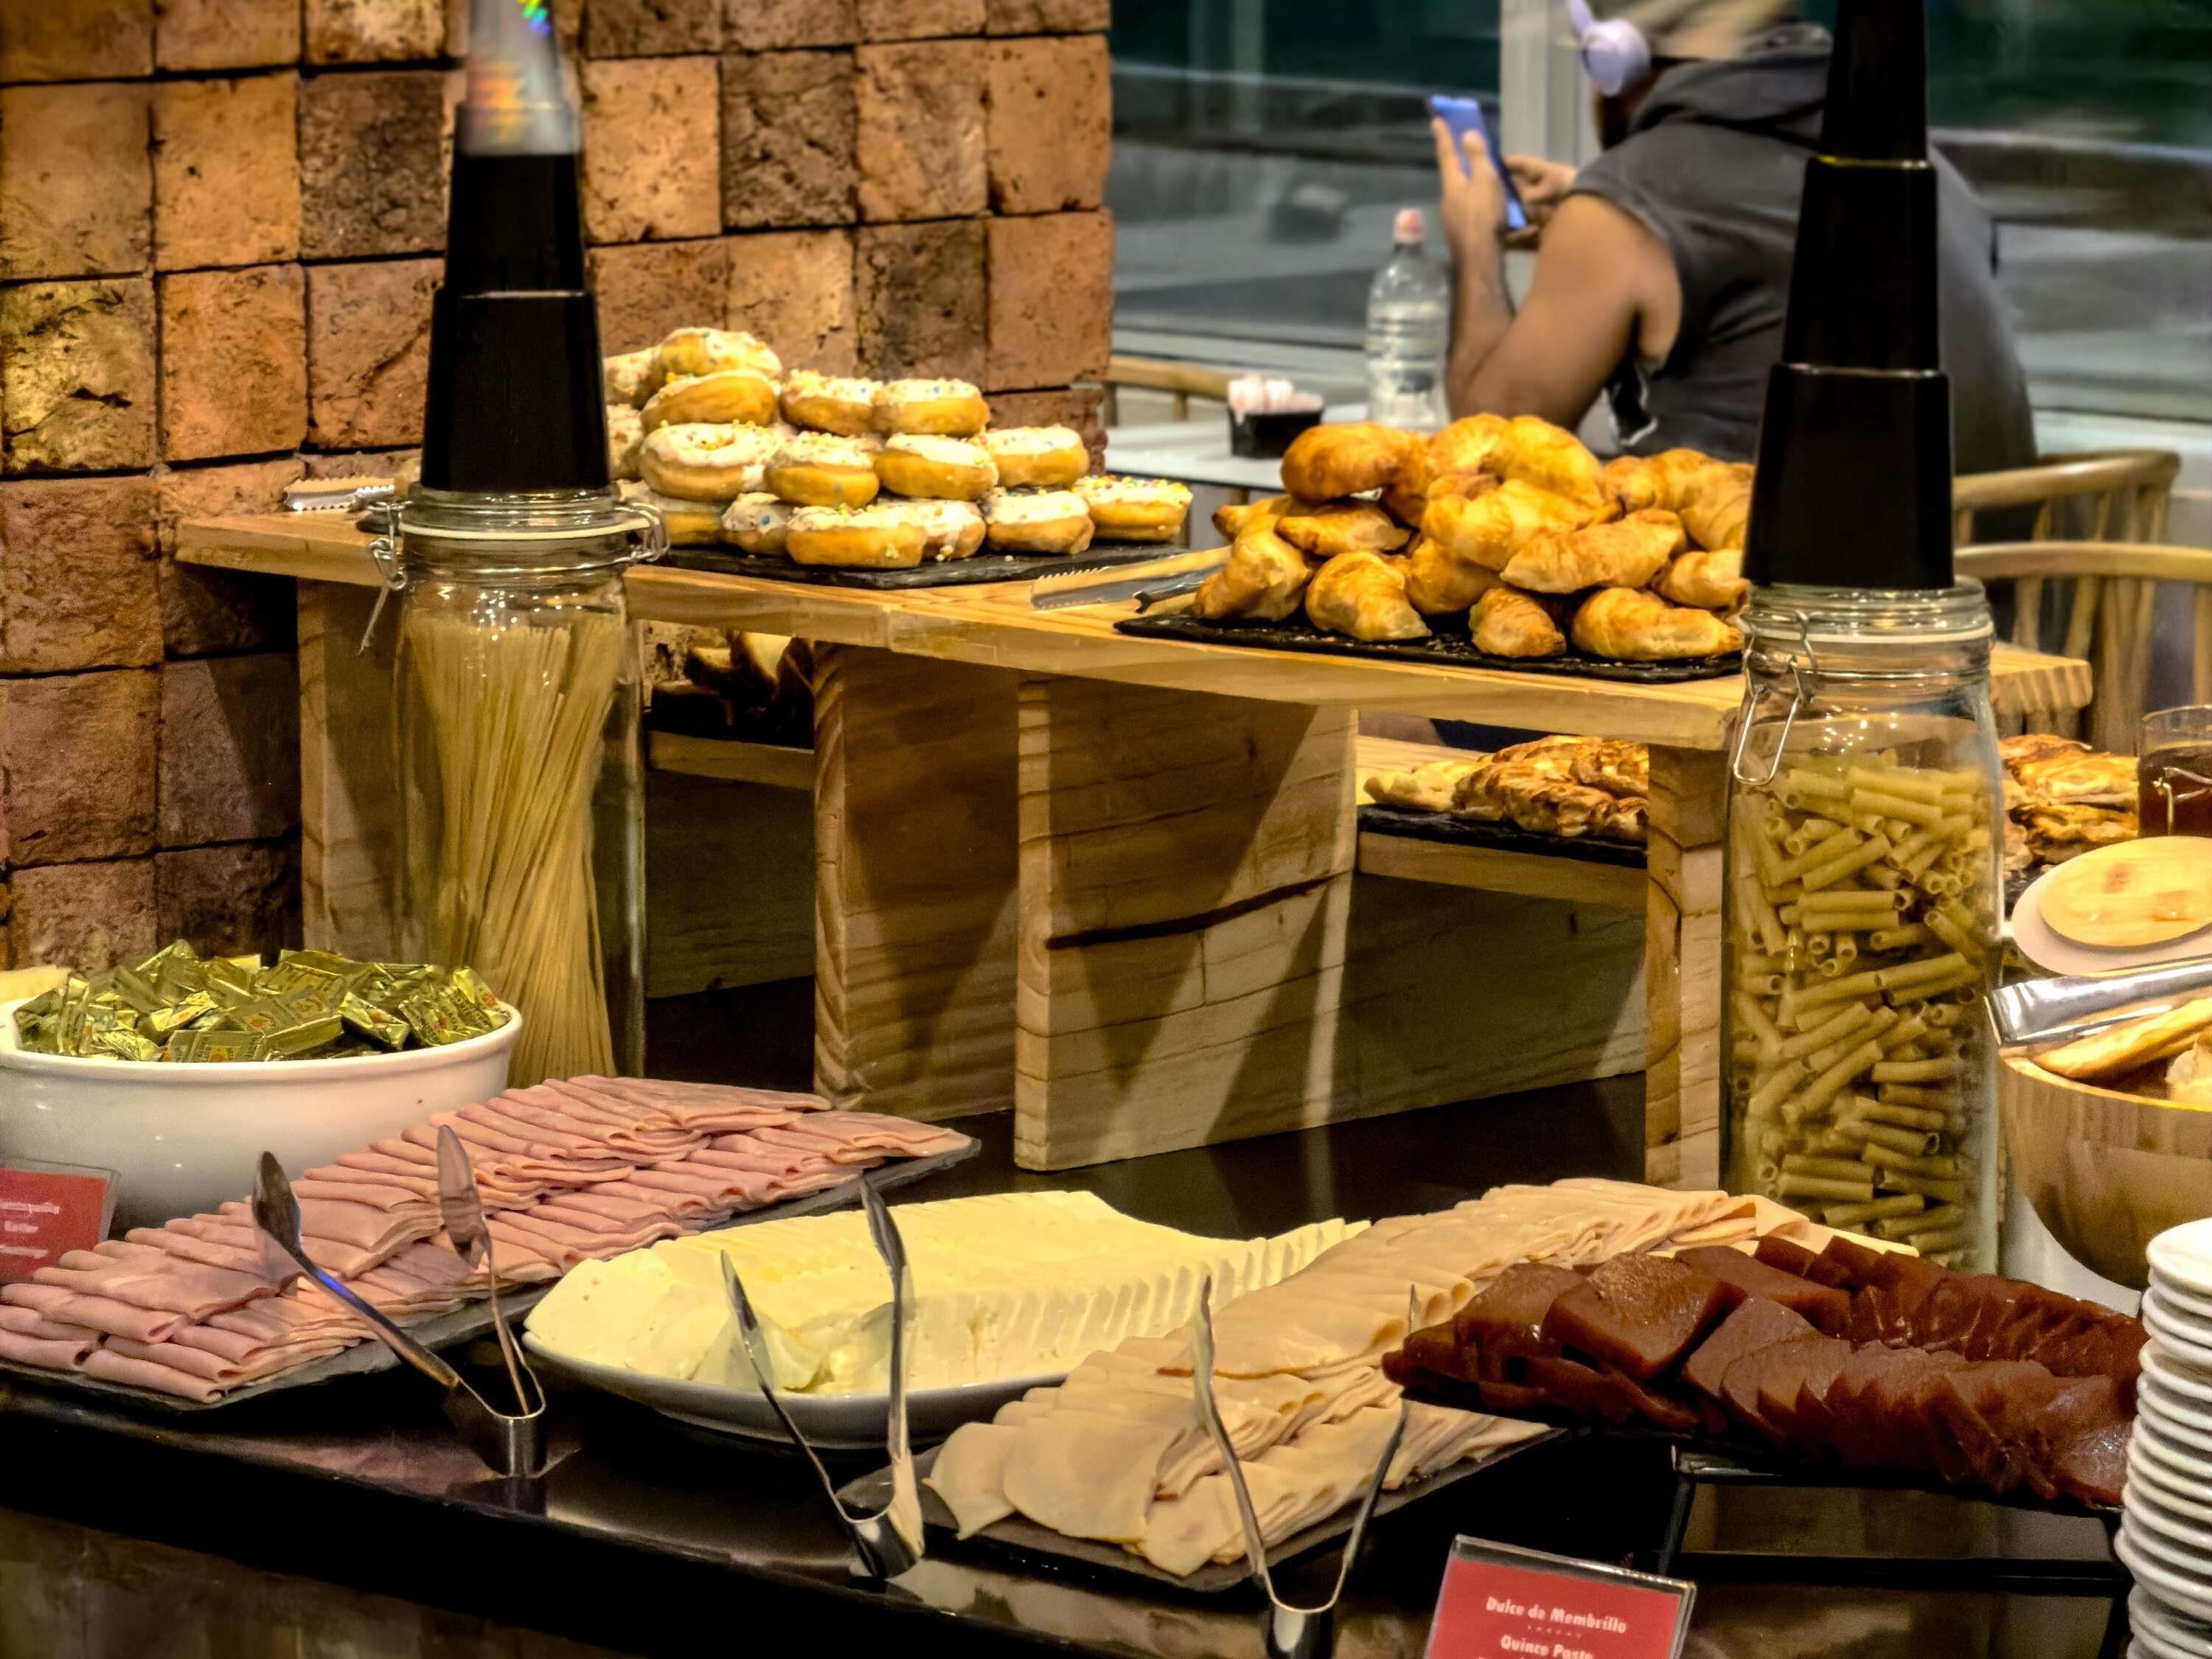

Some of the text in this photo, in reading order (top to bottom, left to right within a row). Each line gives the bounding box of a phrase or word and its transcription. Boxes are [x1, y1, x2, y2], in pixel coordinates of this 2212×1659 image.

[1486, 1596, 1627, 1633] Dulce de Membrillo
[1500, 1635, 1549, 1657] Quince
